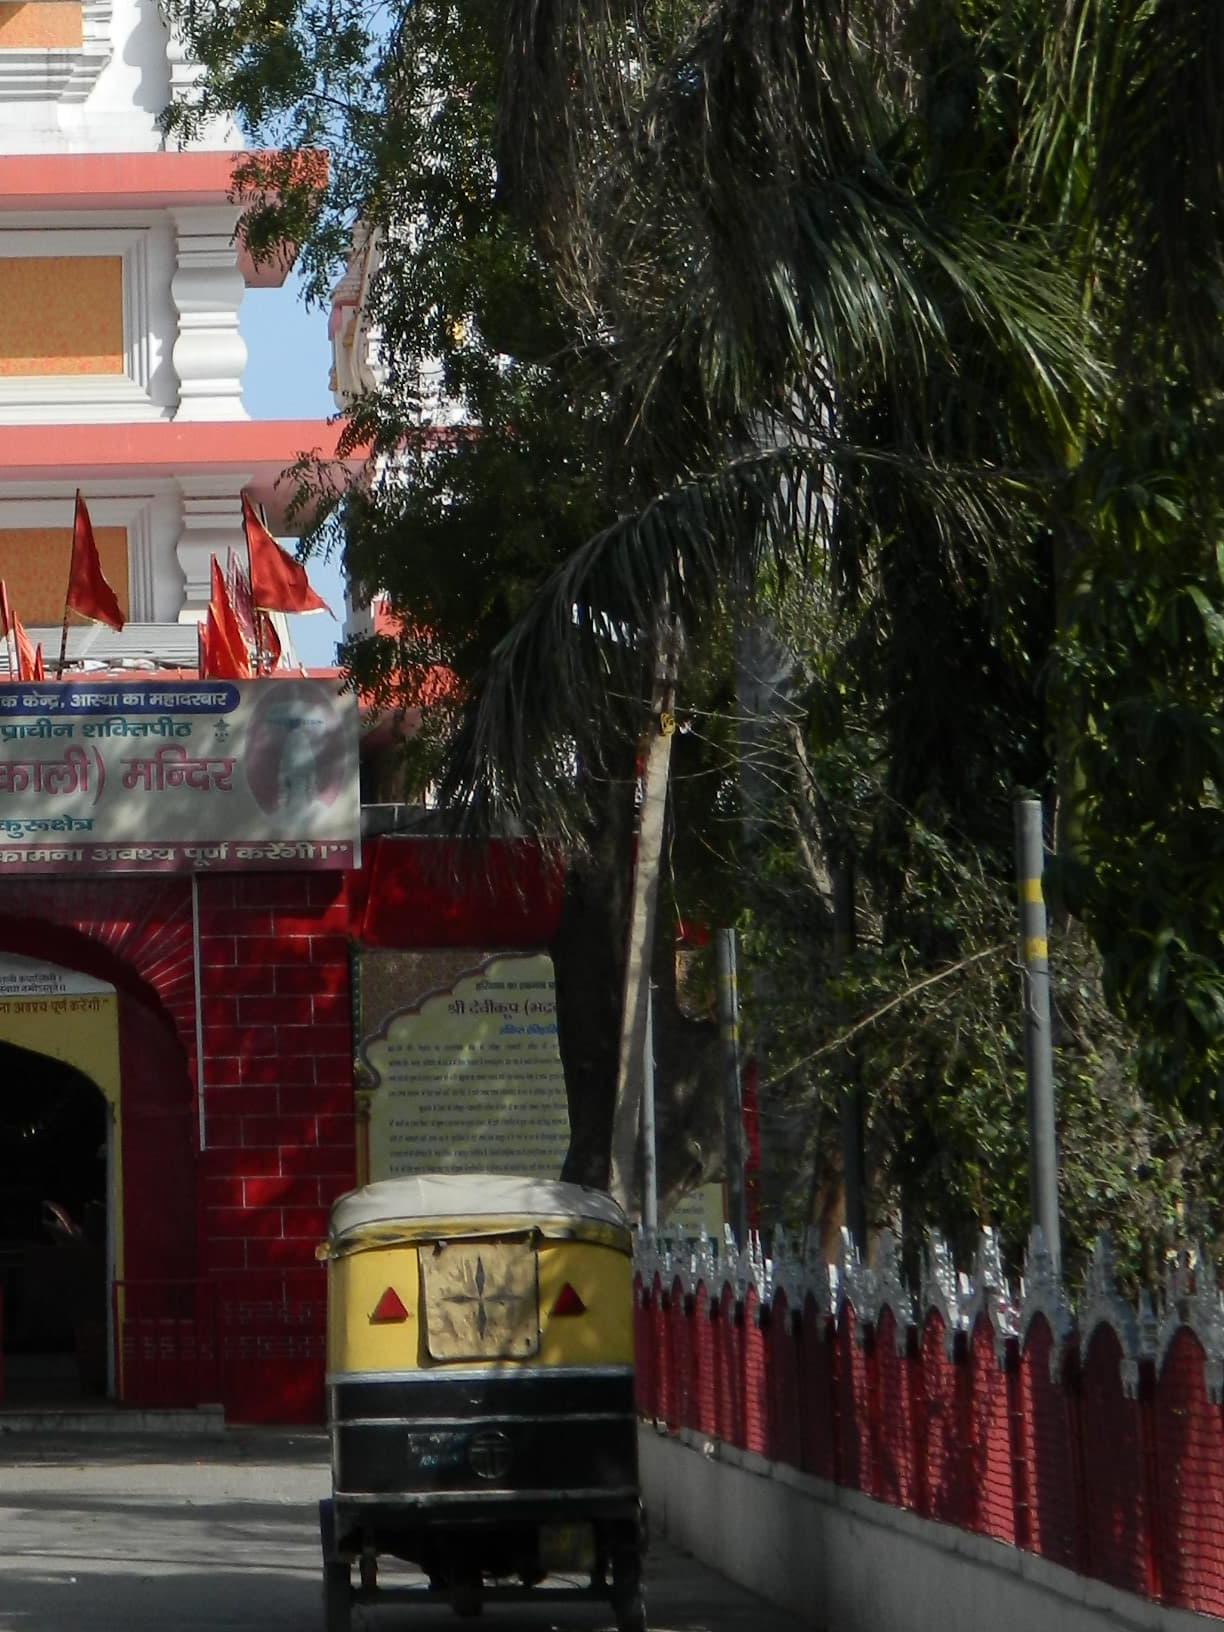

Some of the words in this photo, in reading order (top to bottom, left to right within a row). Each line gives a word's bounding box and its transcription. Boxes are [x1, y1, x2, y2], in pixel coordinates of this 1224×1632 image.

[123, 692, 145, 706] का
[149, 692, 227, 707] महादरबार
[0, 718, 75, 742] प्राचीन
[120, 744, 236, 792] मन्दिर
[91, 847, 175, 862] अवश्य
[184, 842, 228, 866] पूर्ण
